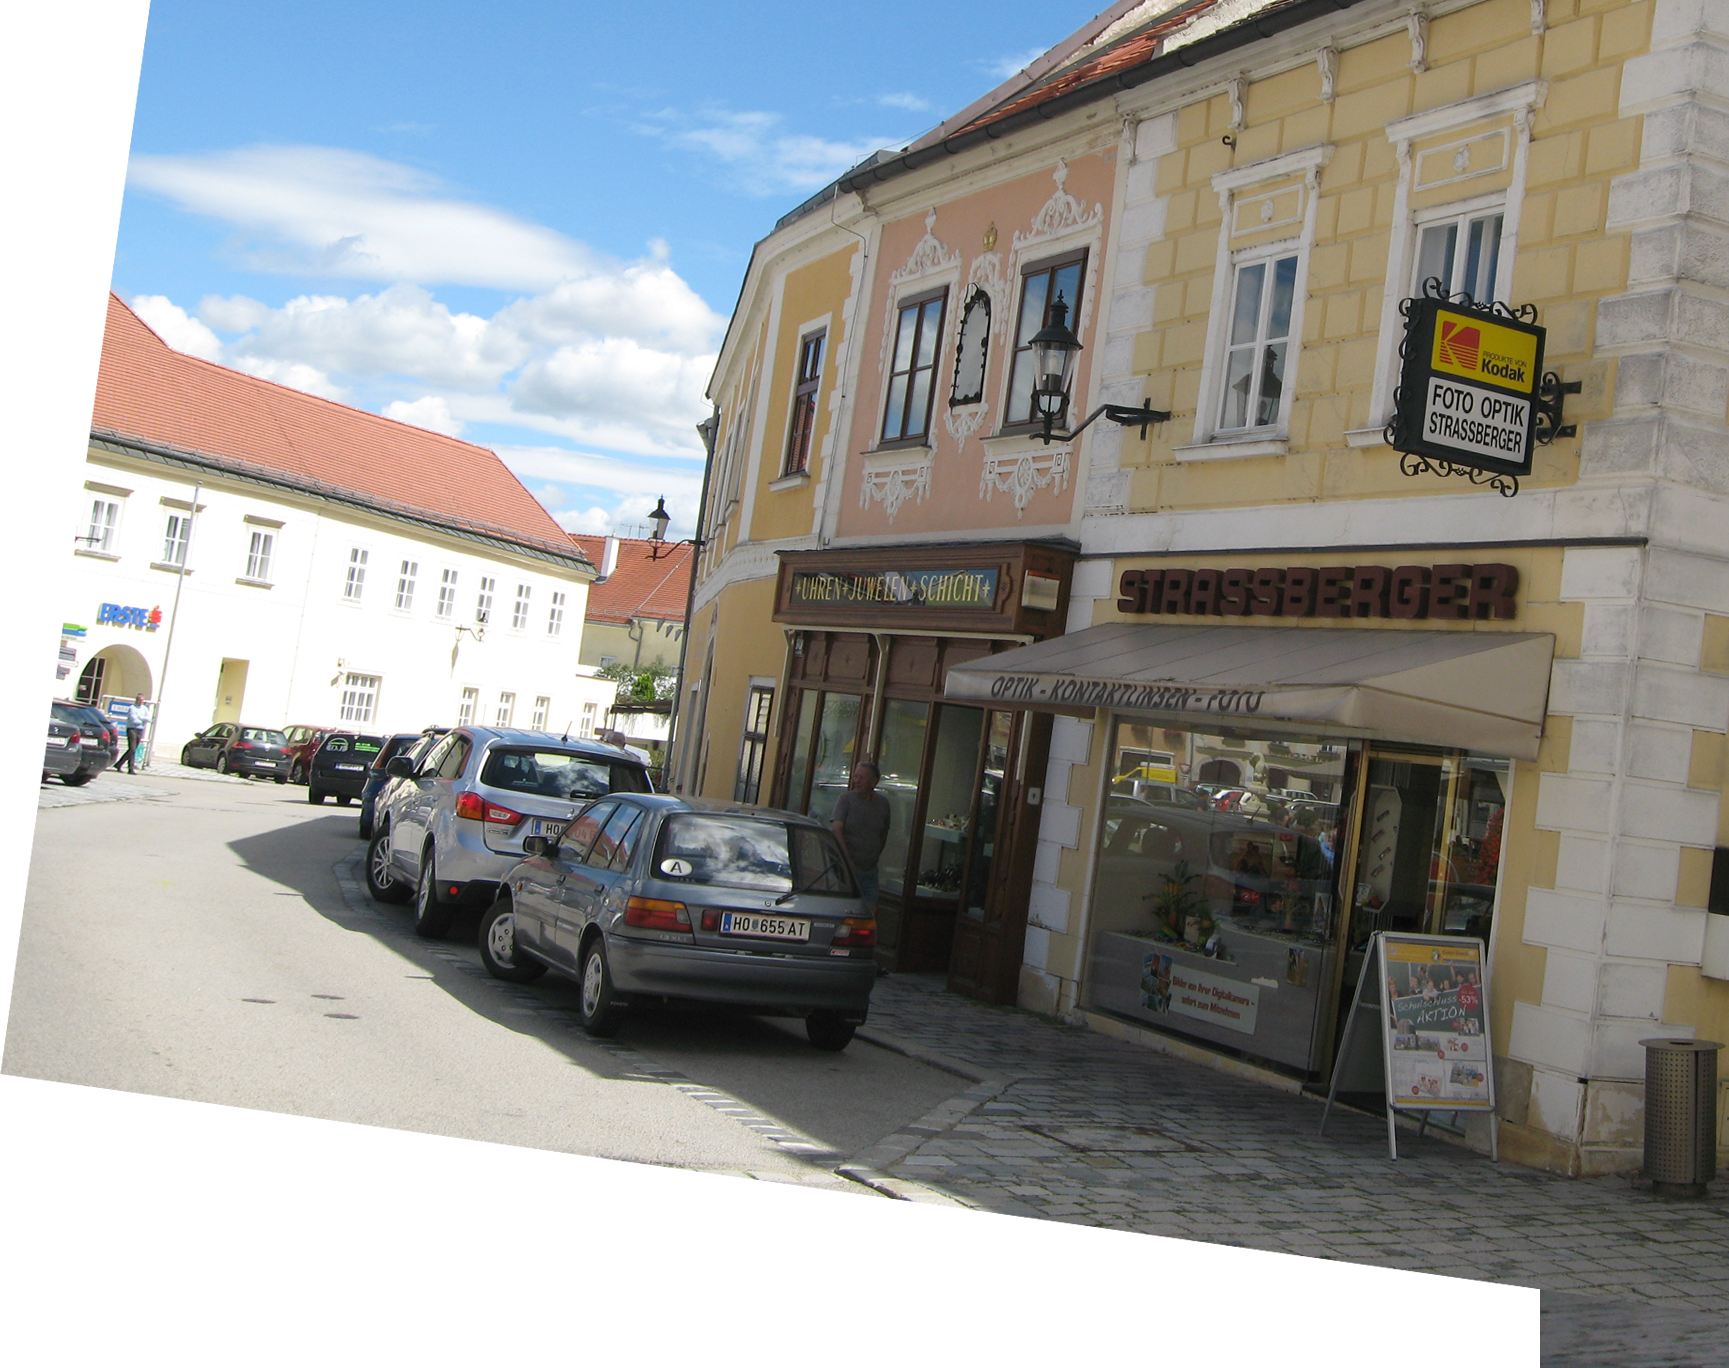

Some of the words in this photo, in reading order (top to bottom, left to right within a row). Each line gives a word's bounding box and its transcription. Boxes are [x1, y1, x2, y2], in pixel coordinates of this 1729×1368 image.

[1481, 358, 1526, 383] Kodak
[1483, 350, 1514, 365] PRODUKTE
[1514, 358, 1528, 369] VON
[1432, 384, 1474, 414] FOTO
[1480, 396, 1526, 427] OPTIK
[1429, 411, 1522, 453] STRASSBERGER
[801, 576, 841, 601] UHREN
[848, 573, 909, 601] JUWELEN
[919, 574, 984, 602] SCHICHT
[1117, 563, 1519, 620] STRASSBERGER
[99, 602, 148, 627] ERSTE
[990, 675, 1041, 700] OPTIK
[1050, 679, 1197, 710] KONTAKTLINSEN
[669, 861, 683, 874] A
[733, 915, 750, 932] HO
[760, 921, 785, 935] 655
[787, 922, 806, 937] AT
[1212, 987, 1249, 1006] Digitalkamera
[1197, 1002, 1208, 1010] zum
[1210, 1003, 1240, 1019] Mitnehmen
[1416, 1003, 1467, 1024] AKTION
